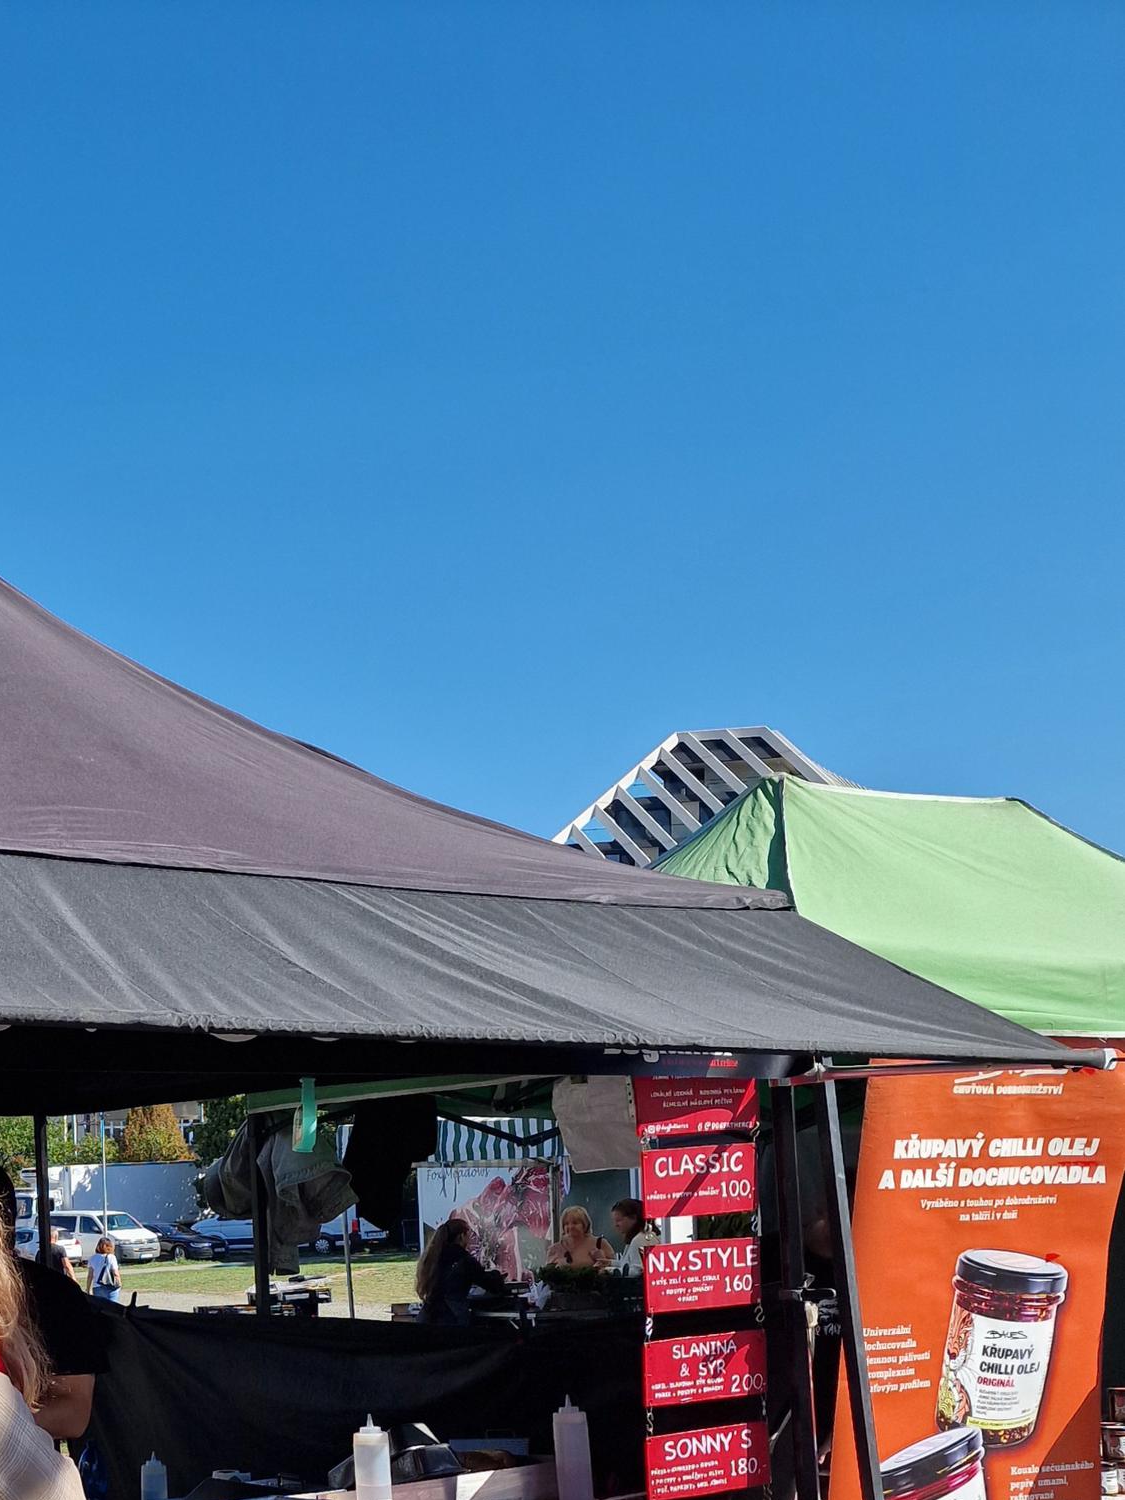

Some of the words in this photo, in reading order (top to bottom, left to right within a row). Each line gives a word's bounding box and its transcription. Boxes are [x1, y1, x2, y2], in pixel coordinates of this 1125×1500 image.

[894, 1132, 984, 1159] KŘUPAVÝ
[988, 1138, 1044, 1156] CHILLI
[1047, 1138, 1100, 1156] OLEJ
[655, 1151, 743, 1178] CLASSIC
[878, 1171, 895, 1189] A
[900, 1161, 956, 1188] DALŠÍ
[958, 1165, 1106, 1187] DOCHUCOVADLA
[920, 1198, 958, 1210] Vyráběno
[967, 1198, 993, 1207] touhou
[995, 1199, 1004, 1208] po
[959, 1213, 970, 1221] na
[672, 1340, 736, 1359] SLANINA
[982, 1344, 1034, 1359] KŘUPAVÝ
[680, 1363, 689, 1376] &
[699, 1357, 726, 1376] SÝR
[980, 1361, 1015, 1375] CHILLI
[1017, 1362, 1040, 1375] OLEJ
[664, 1429, 752, 1461] SONNY'S
[1011, 1466, 1039, 1475] Kouzlo
